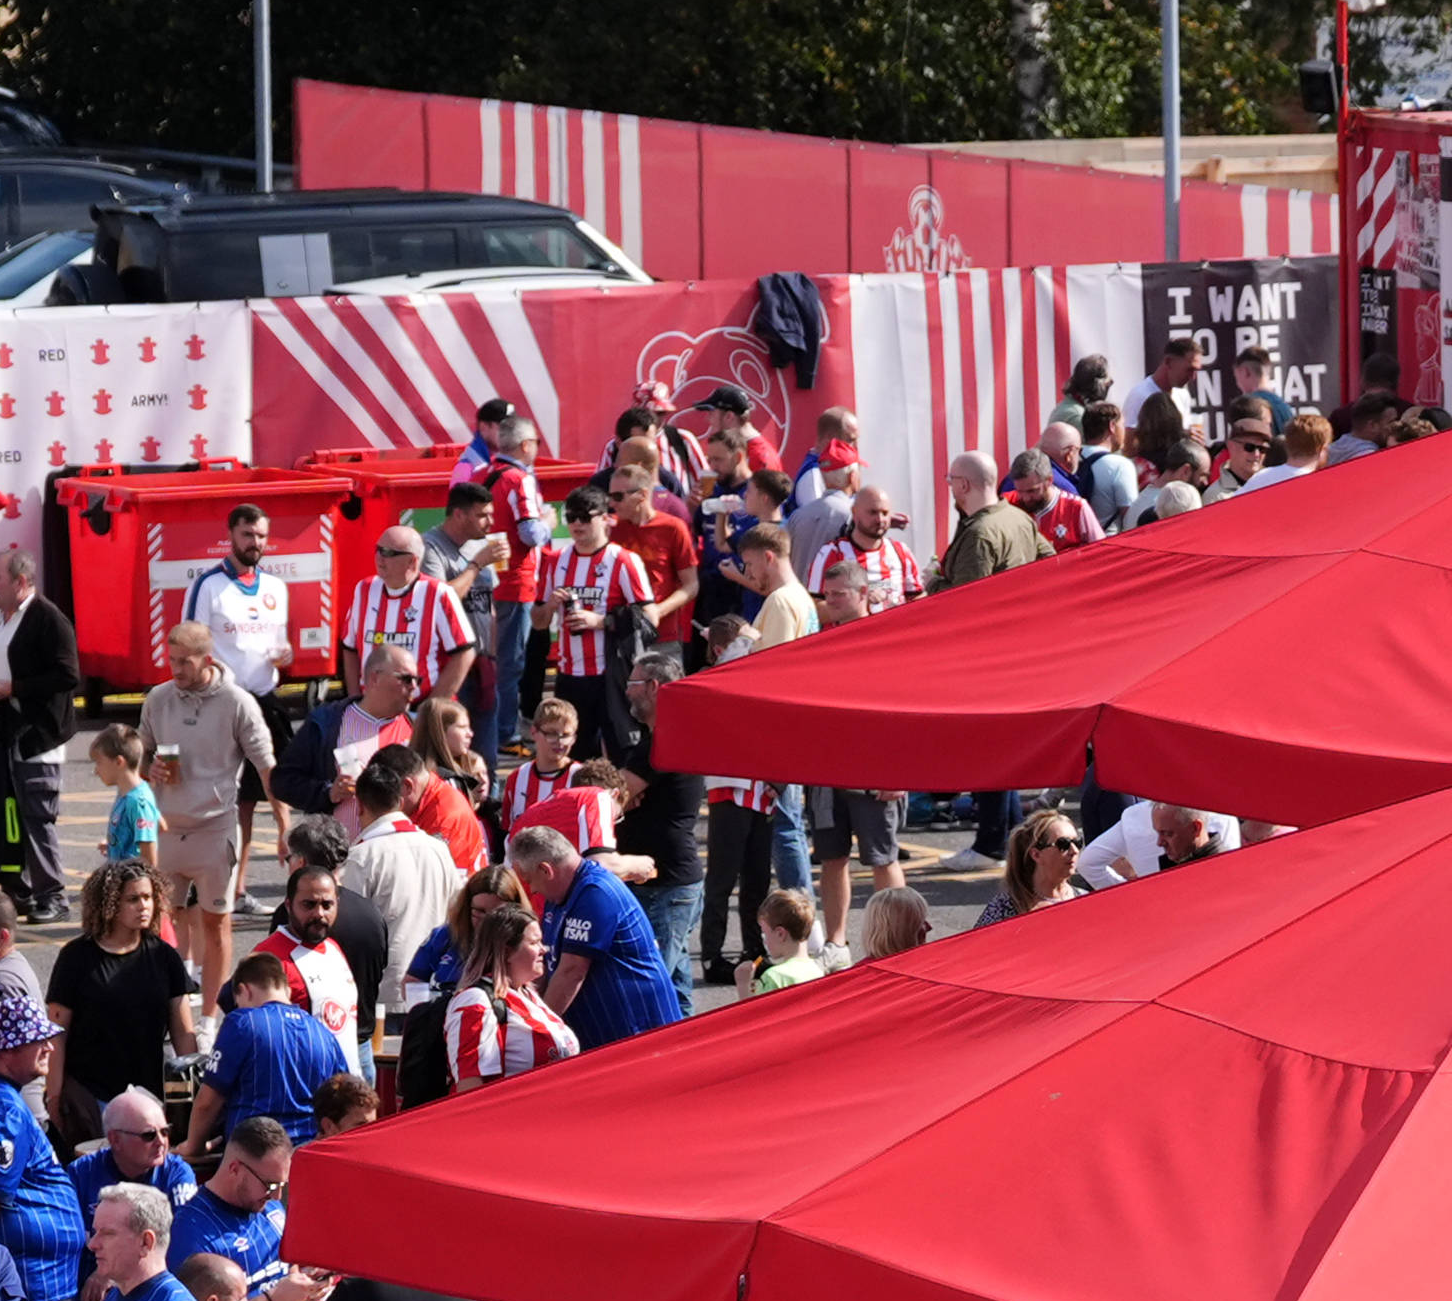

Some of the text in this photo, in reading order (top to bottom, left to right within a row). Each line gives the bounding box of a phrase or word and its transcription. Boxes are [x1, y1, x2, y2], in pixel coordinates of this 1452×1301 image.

[1167, 281, 1302, 326] I WANT
[38, 348, 66, 362] RED
[130, 394, 169, 408] ARMY!
